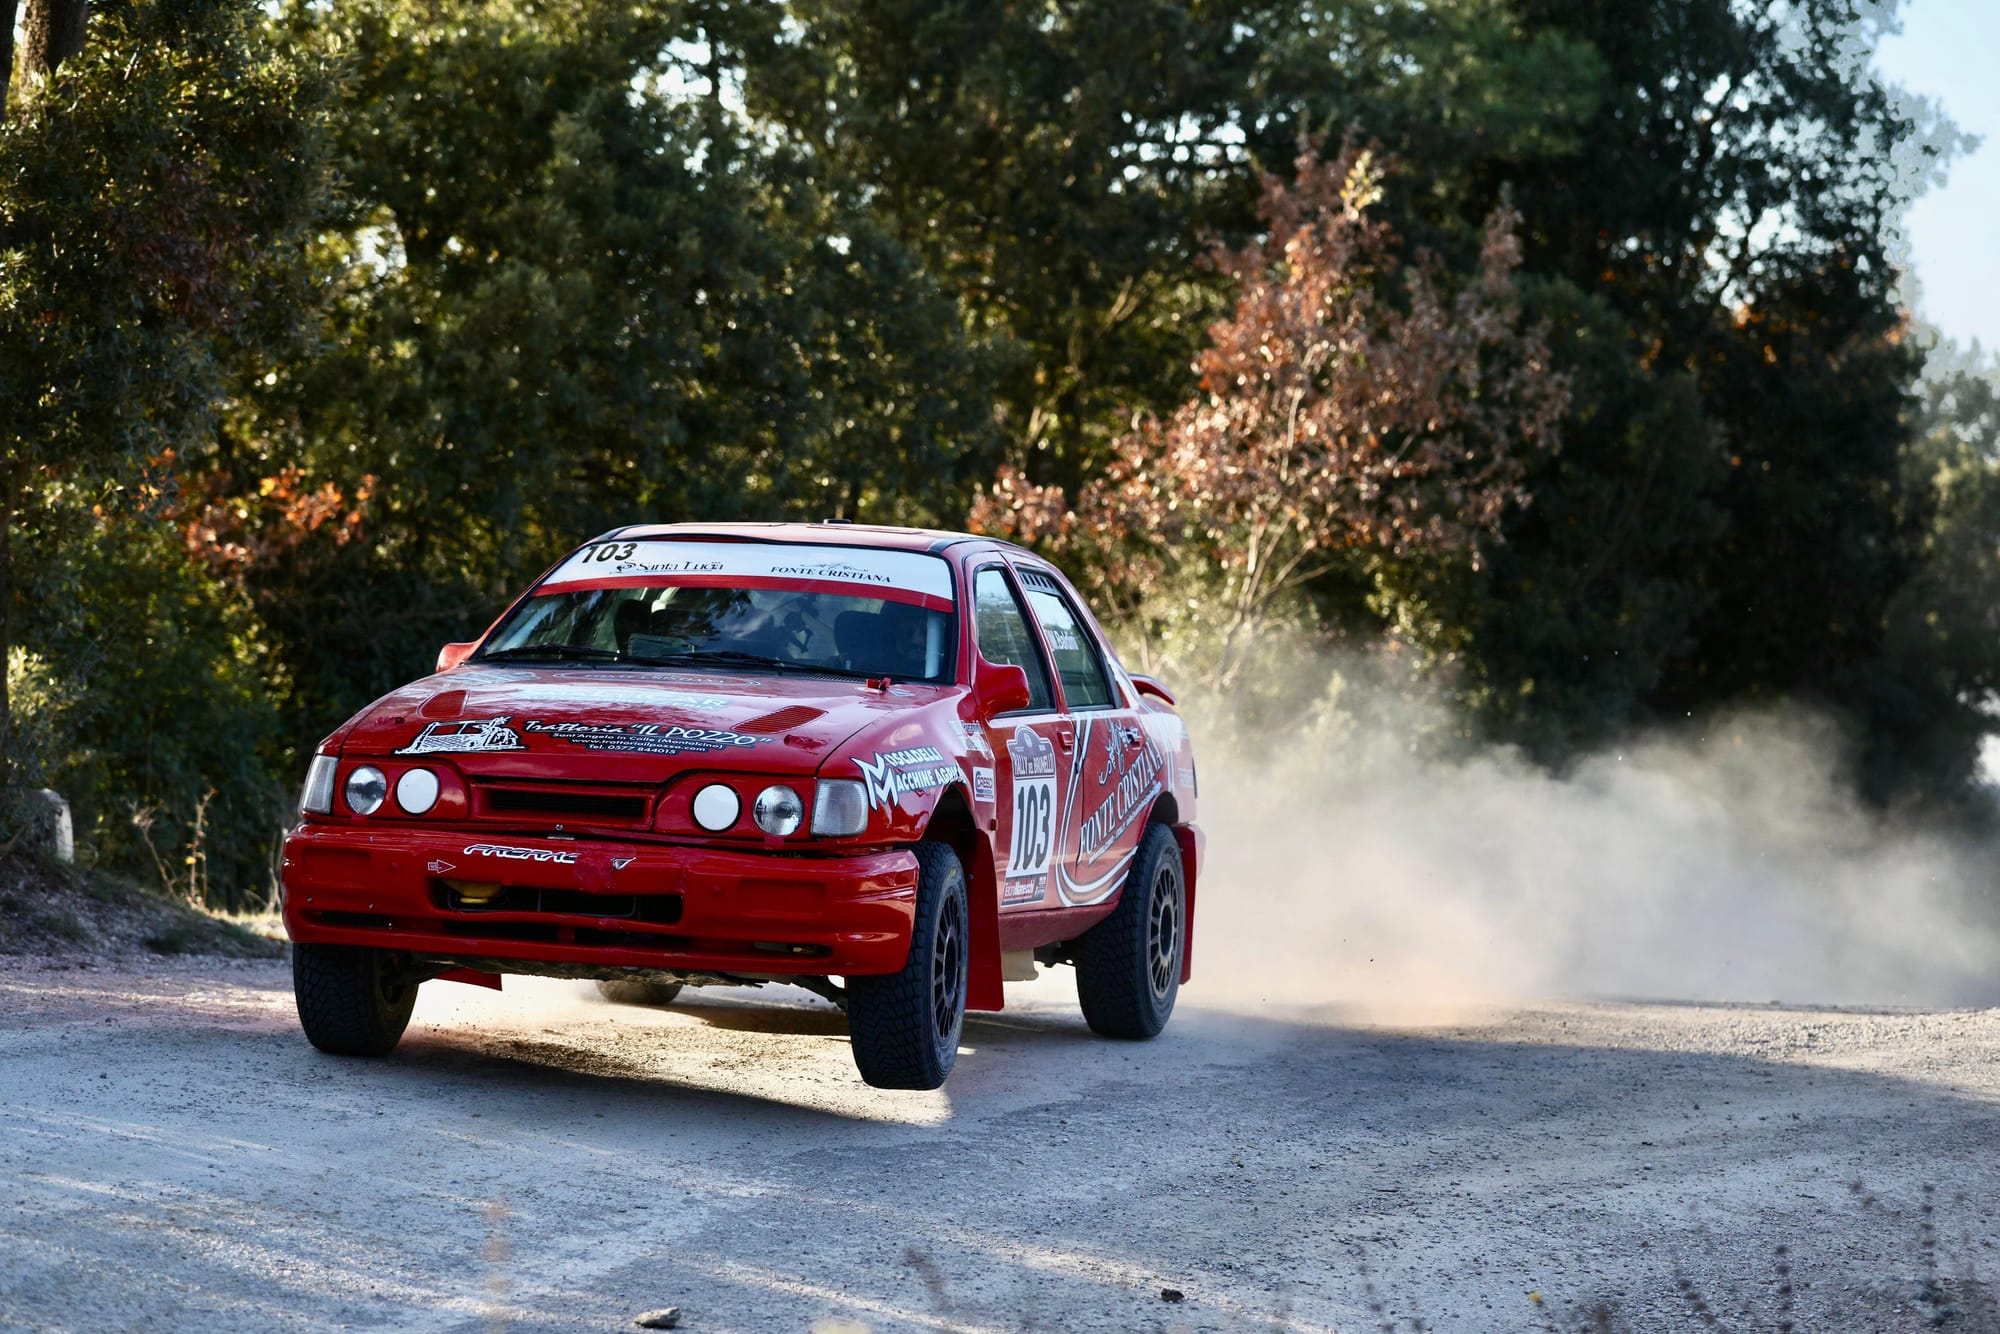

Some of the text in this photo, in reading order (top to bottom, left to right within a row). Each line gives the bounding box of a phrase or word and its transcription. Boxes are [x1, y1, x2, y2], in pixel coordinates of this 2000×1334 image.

[582, 542, 637, 563] 103
[770, 566, 891, 583] FONTE CRISTIANA
[525, 720, 625, 734] Trattoria
[1078, 792, 1116, 865] FONTE
[1117, 736, 1164, 820] CRISTIANA
[1013, 784, 1050, 870] 103
